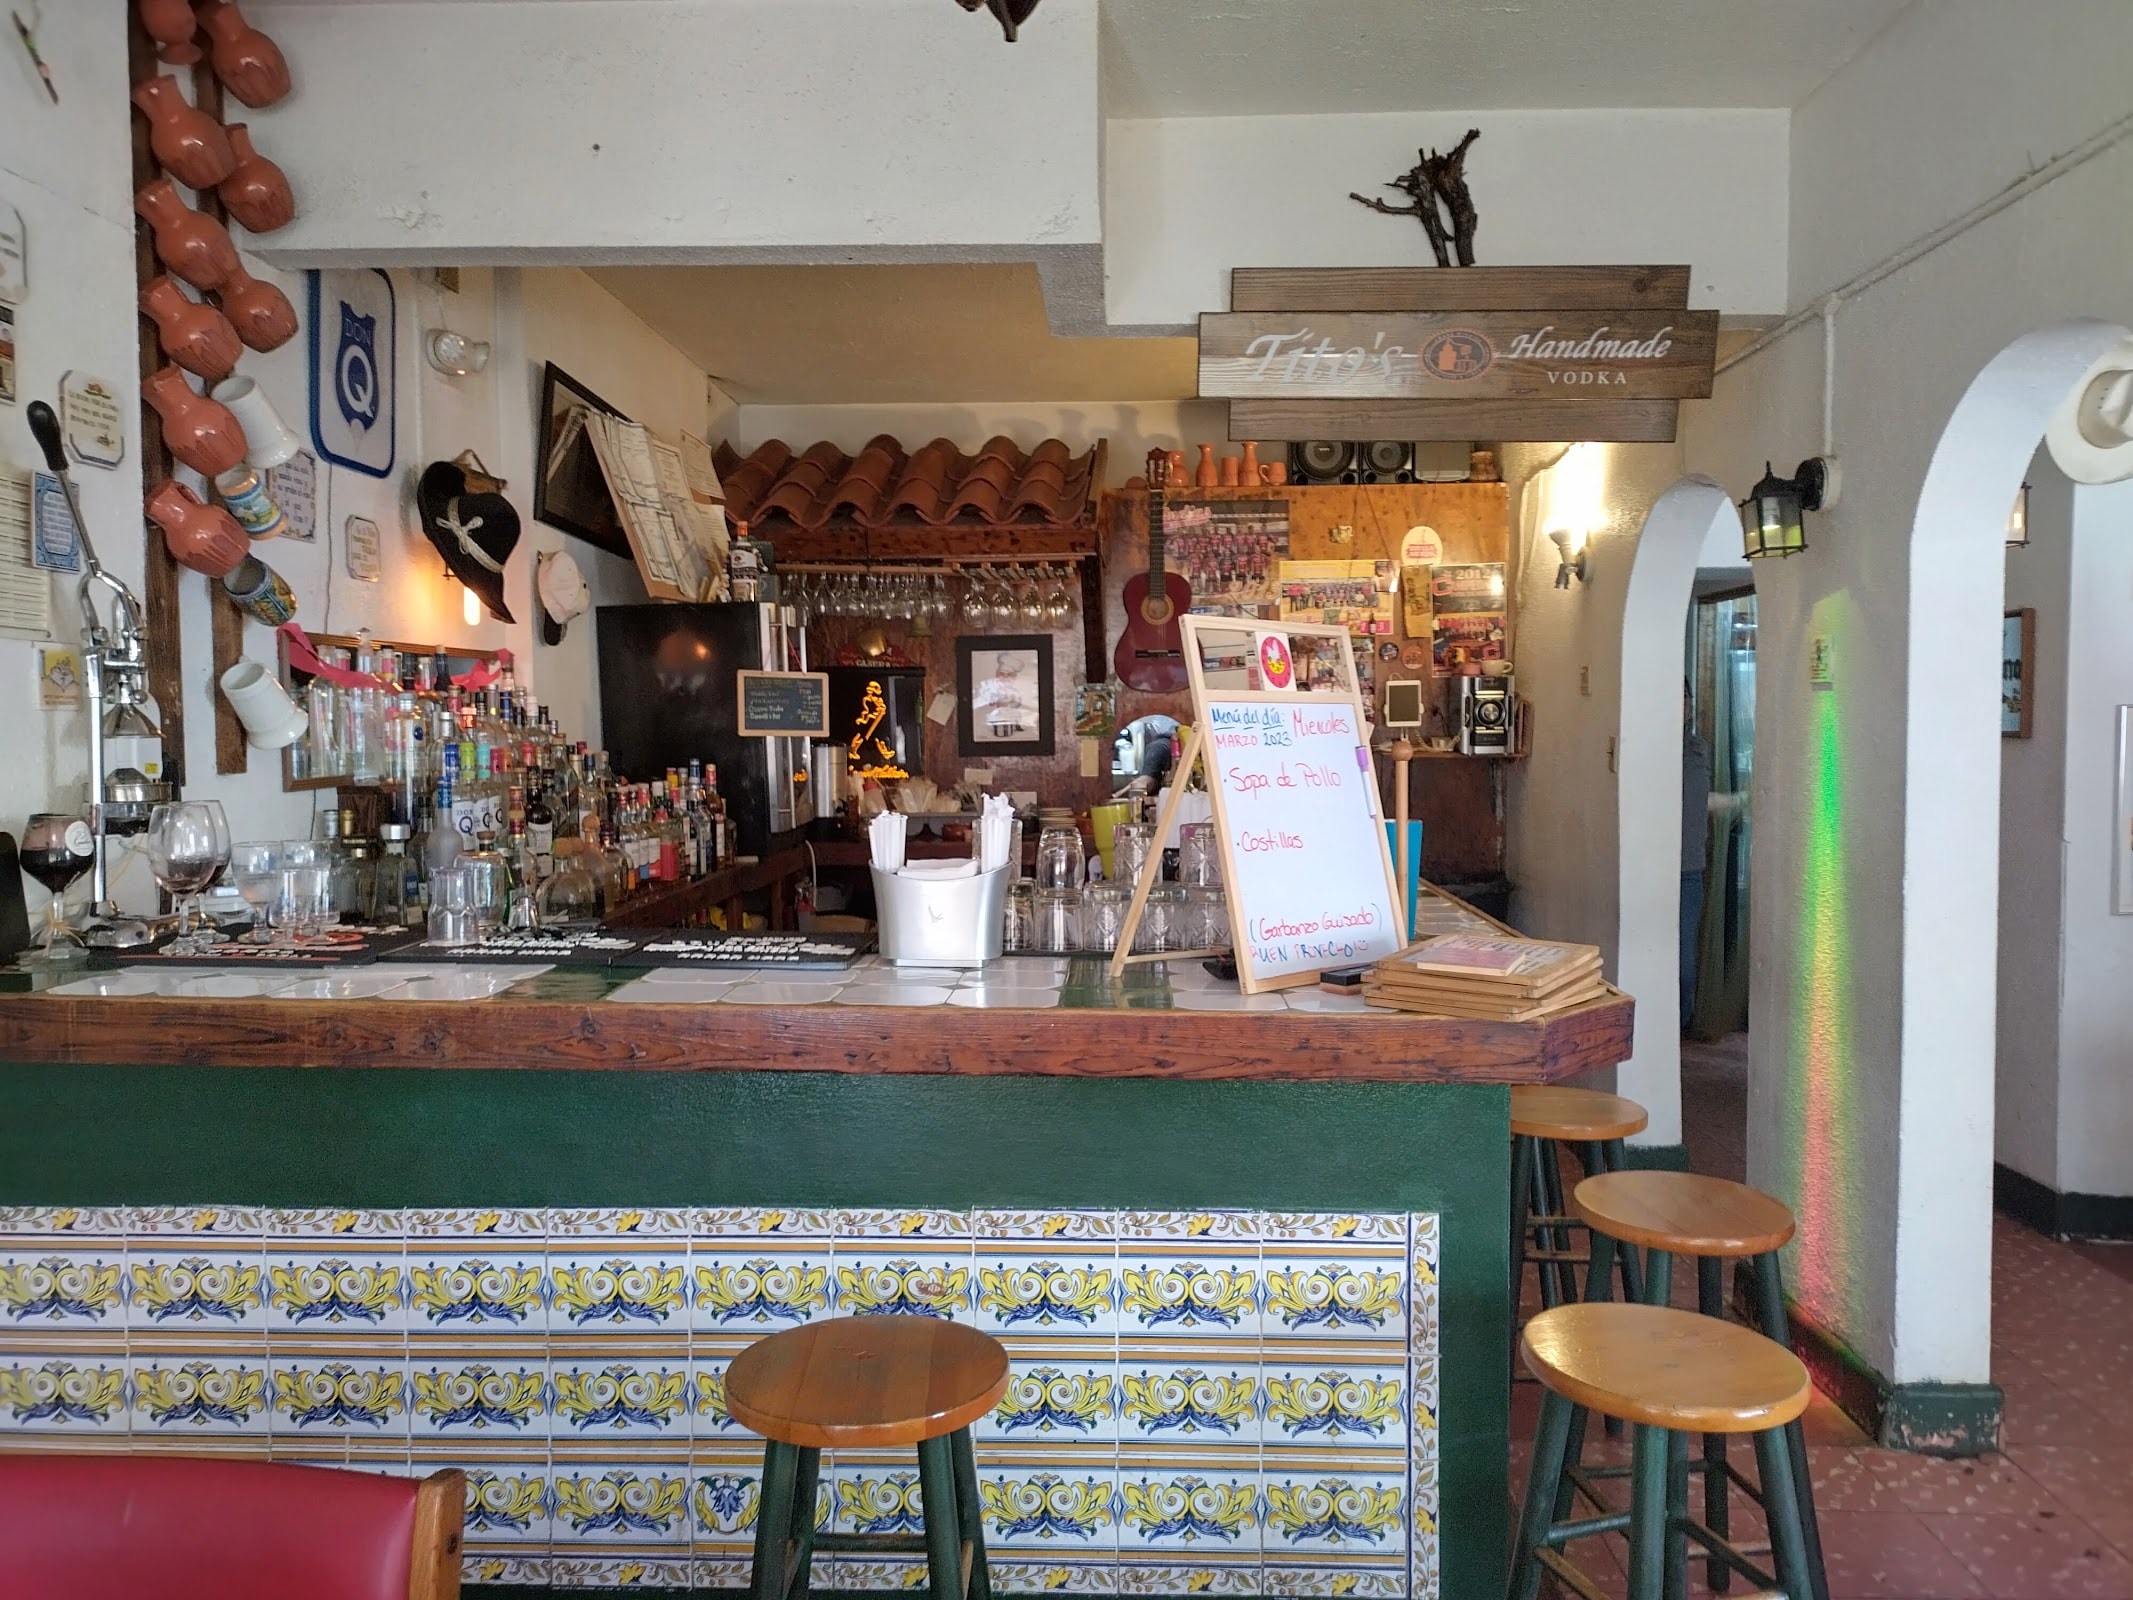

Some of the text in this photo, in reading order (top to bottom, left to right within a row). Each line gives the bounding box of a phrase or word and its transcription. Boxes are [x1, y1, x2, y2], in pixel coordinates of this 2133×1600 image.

[344, 317, 372, 346] DON
[1245, 327, 1403, 383] Tito's
[1507, 325, 1674, 360] Handmade
[342, 344, 374, 418] Q
[1547, 371, 1627, 385] VODKA
[1456, 568, 1491, 581] 2012
[1211, 708, 1241, 725] Menú
[1243, 710, 1260, 725] del
[1215, 731, 1292, 749] MARZO 2023
[1229, 761, 1341, 800] Sopa de Pollo
[459, 816, 474, 836] Q
[1241, 829, 1303, 851] Costillas
